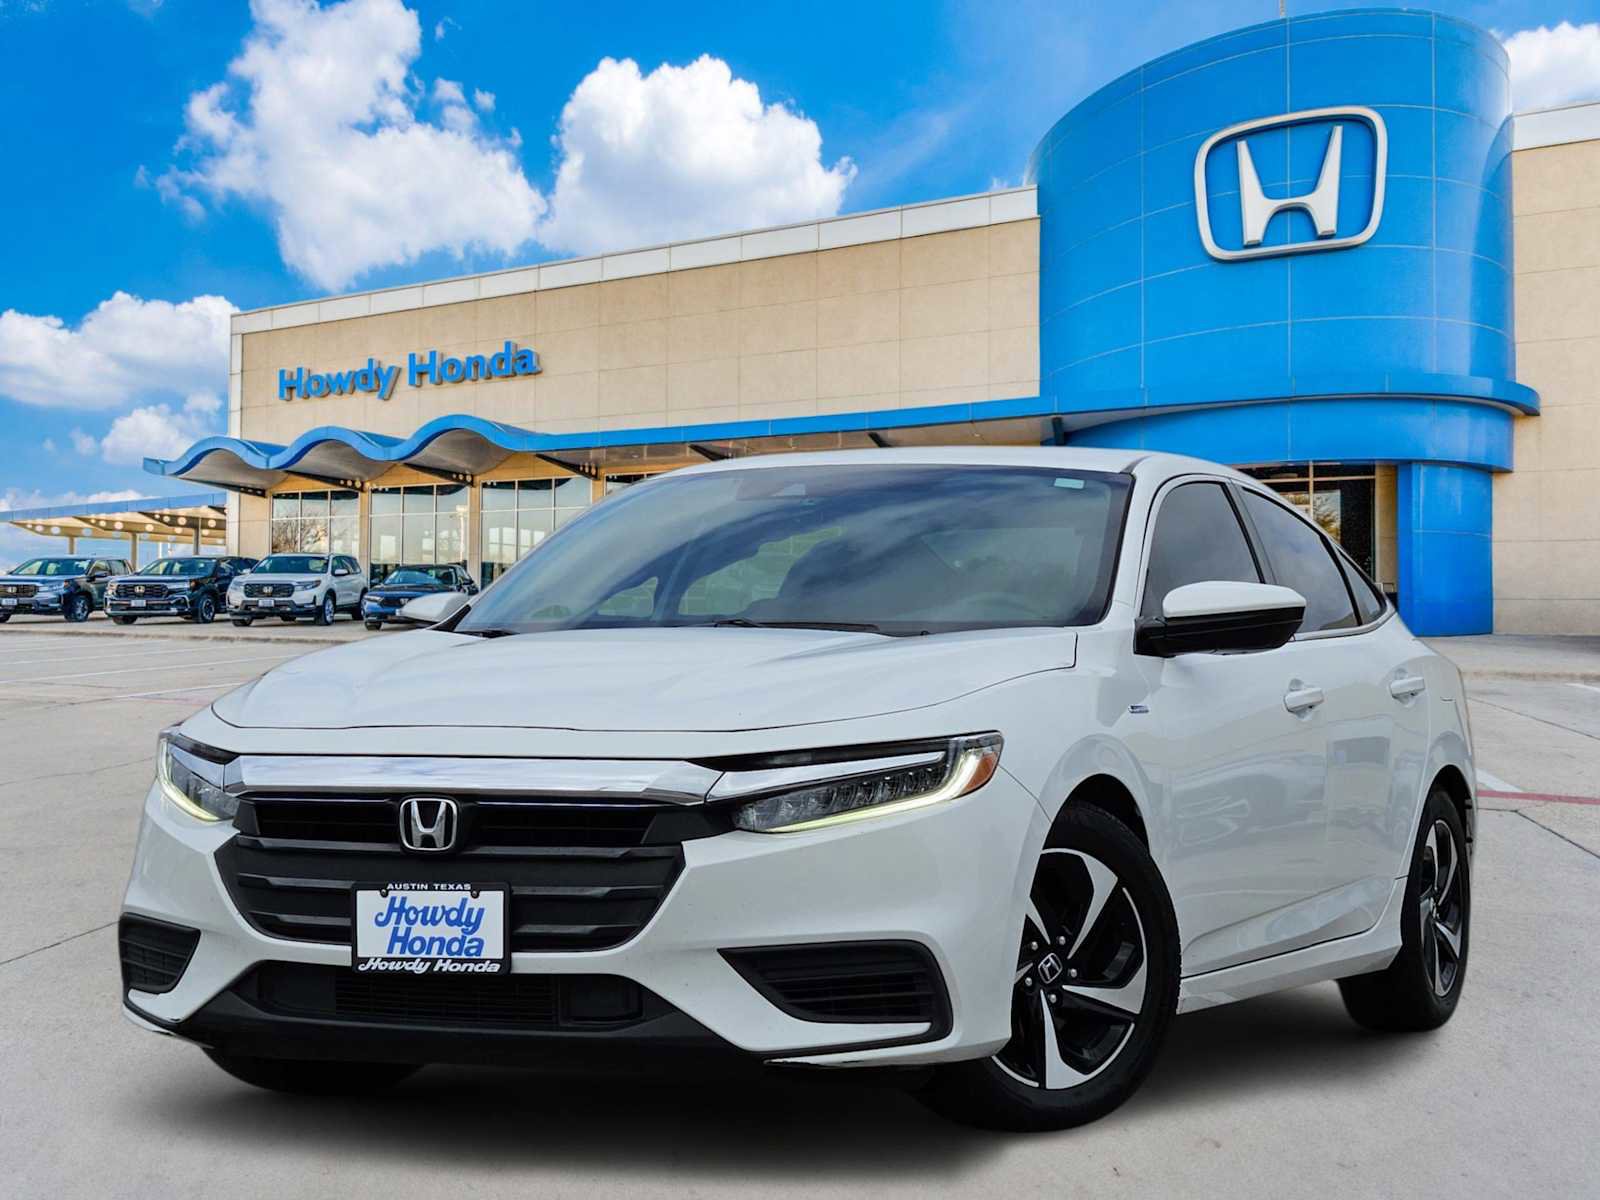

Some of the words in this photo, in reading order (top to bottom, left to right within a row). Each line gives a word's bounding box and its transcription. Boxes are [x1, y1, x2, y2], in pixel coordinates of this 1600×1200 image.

[278, 357, 402, 401] Howdy
[408, 340, 543, 388] Honda
[374, 896, 485, 935] Howdy
[386, 926, 485, 957] Honda
[358, 957, 431, 974] Howdy
[433, 959, 501, 973] Honda
